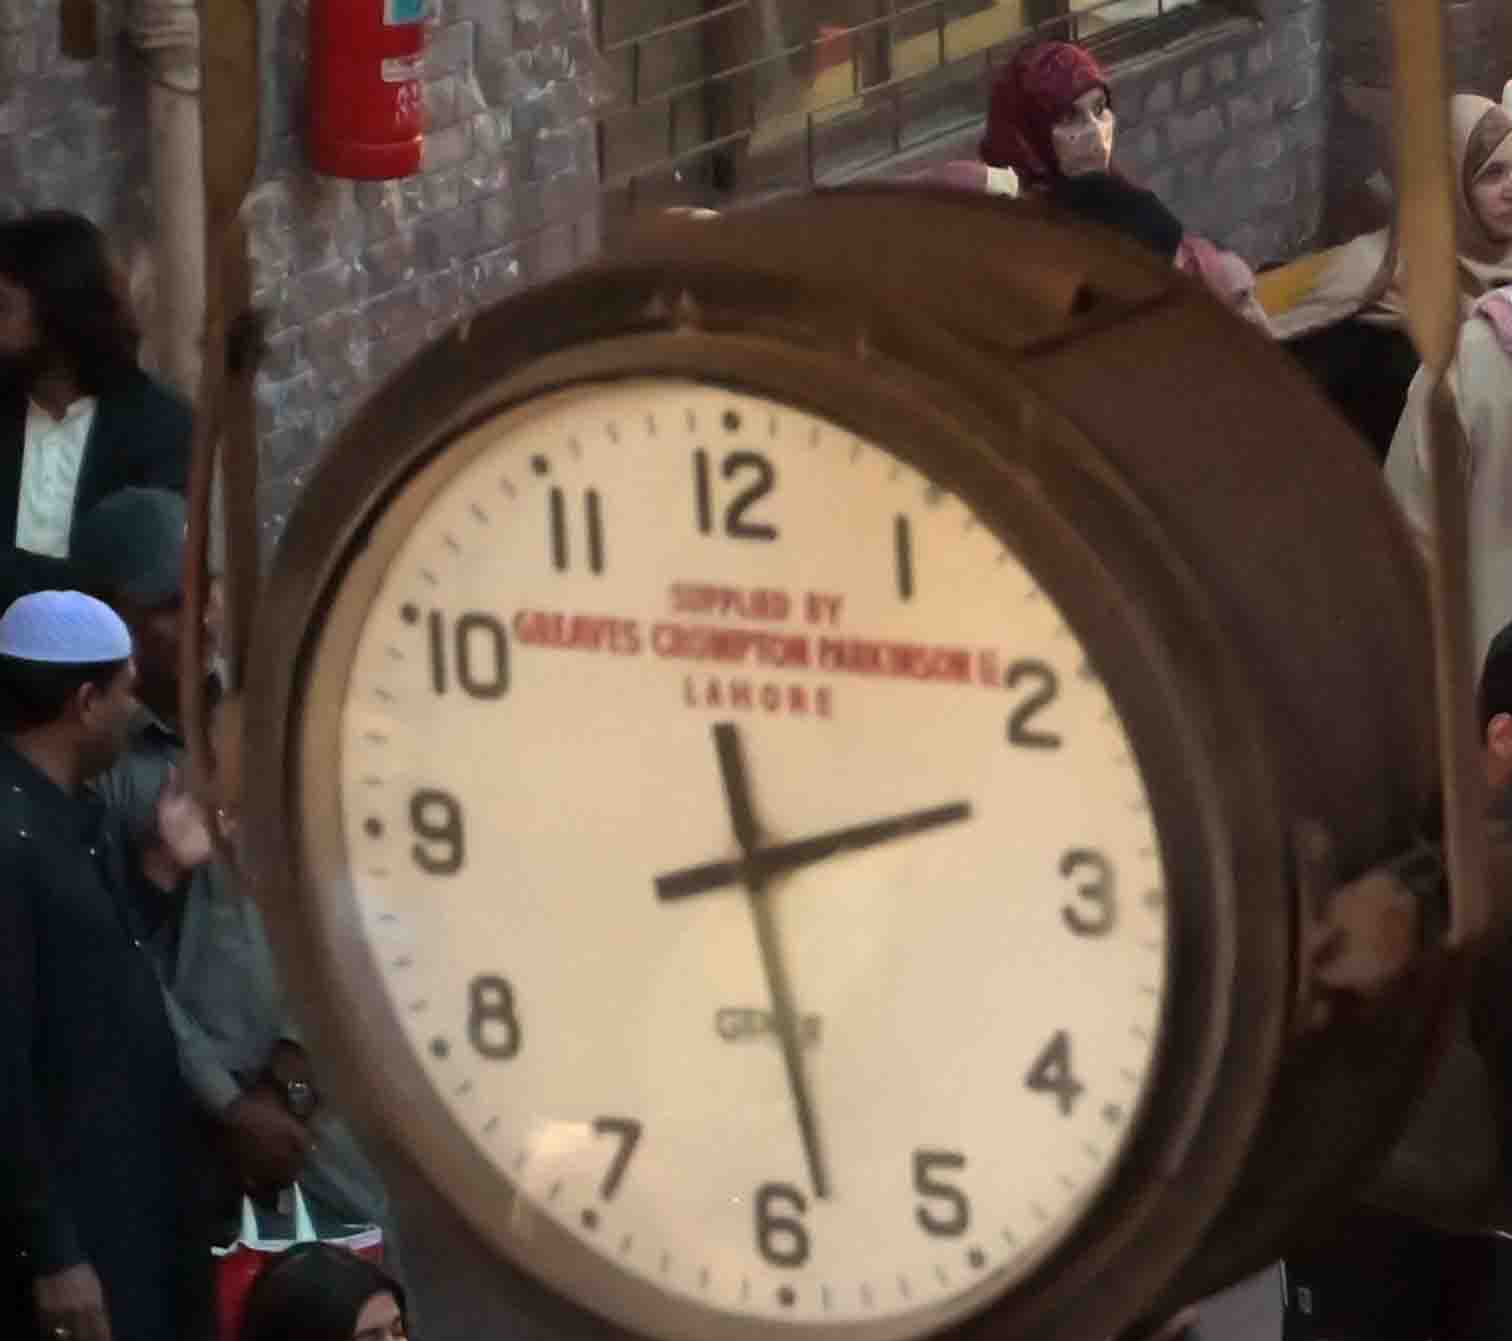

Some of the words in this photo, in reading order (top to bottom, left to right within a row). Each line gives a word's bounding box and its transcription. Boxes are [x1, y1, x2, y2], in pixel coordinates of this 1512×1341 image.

[549, 487, 603, 575] 11
[693, 448, 779, 543] 12
[895, 514, 914, 599] 1
[513, 610, 640, 656] GREAVES
[652, 624, 808, 668] CROMPTON
[819, 634, 973, 684] PARKINSON
[669, 584, 789, 620] SUPPLIED
[805, 594, 844, 624] BY
[429, 610, 509, 700] 10
[684, 675, 834, 718] LAHORE
[1003, 660, 1062, 750] 2
[410, 789, 465, 877] 9
[1058, 849, 1117, 938] 3
[468, 976, 522, 1061] 8
[1025, 1030, 1085, 1115] 4
[593, 1116, 644, 1200] 7
[915, 1149, 971, 1238] 5
[755, 1181, 811, 1269] 6
